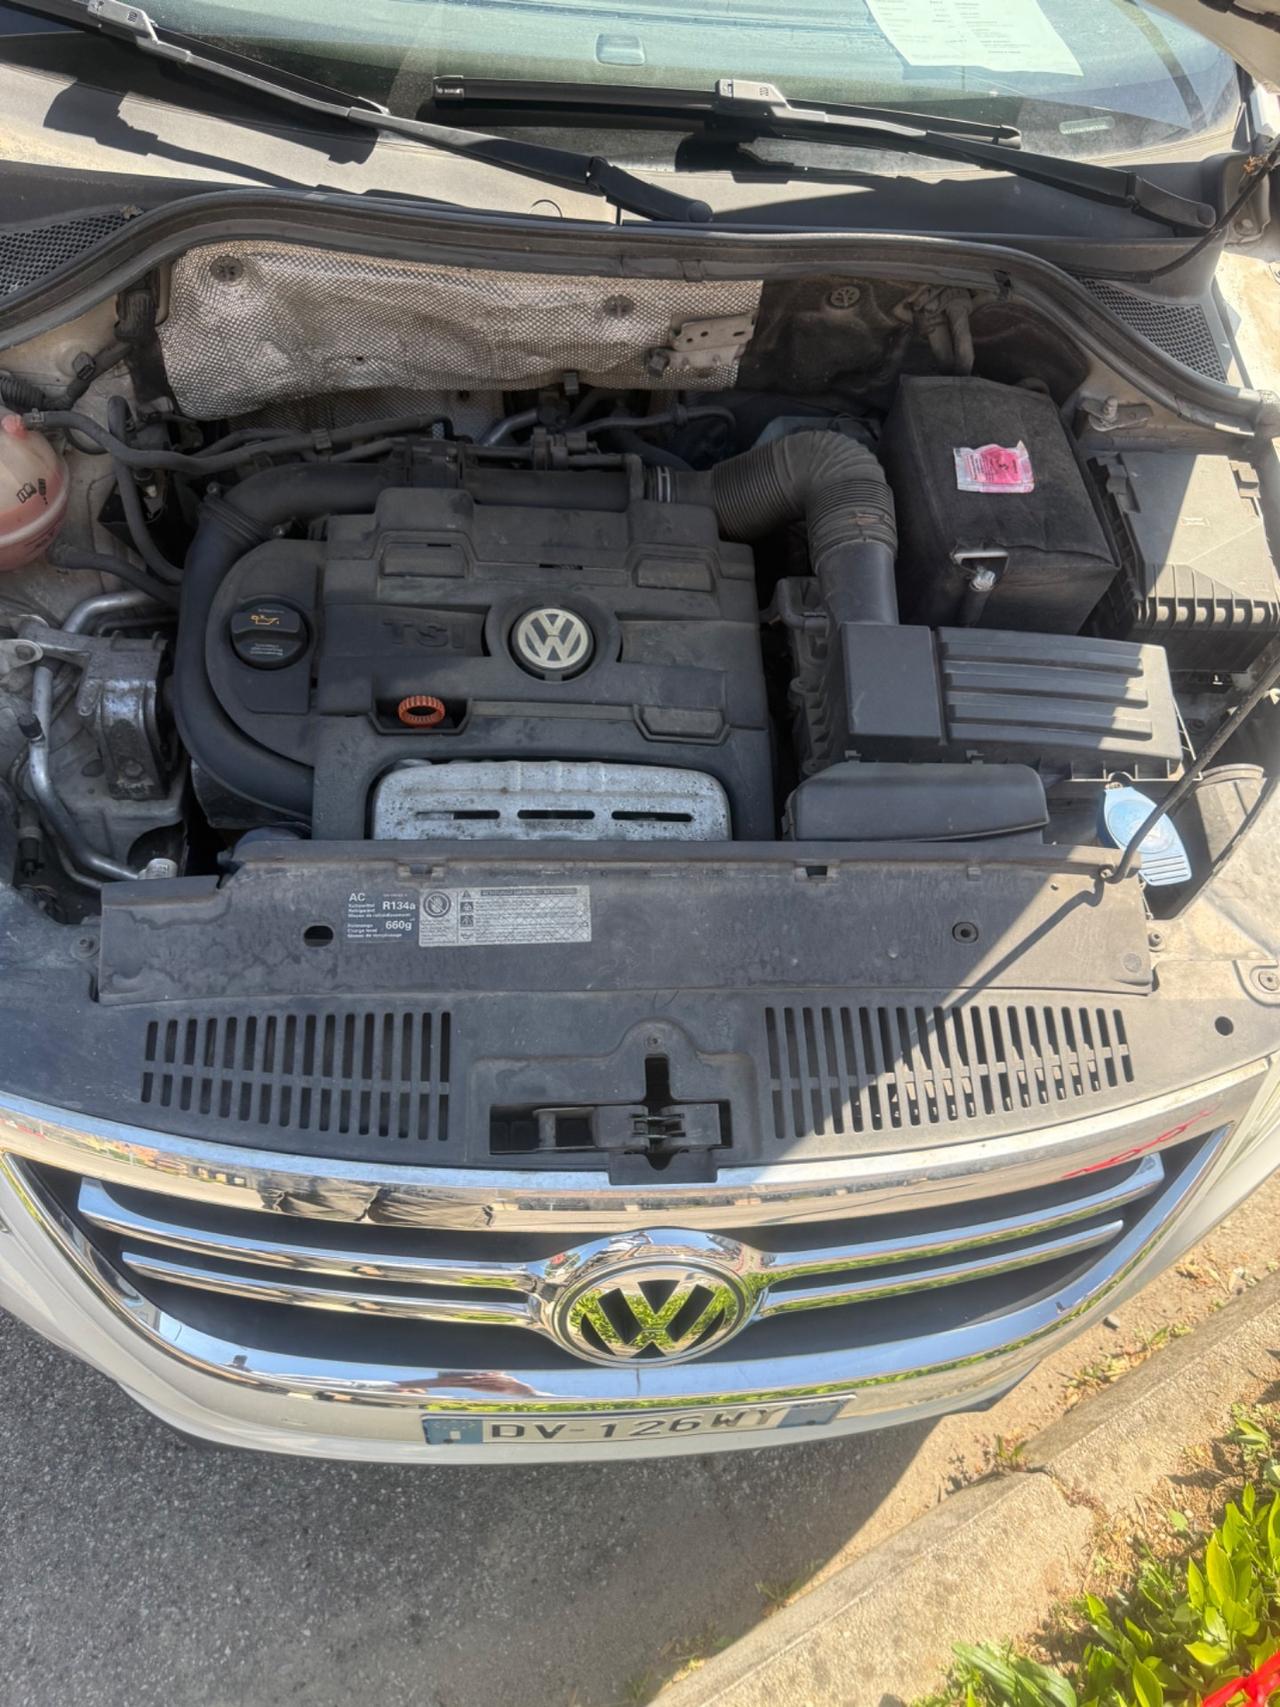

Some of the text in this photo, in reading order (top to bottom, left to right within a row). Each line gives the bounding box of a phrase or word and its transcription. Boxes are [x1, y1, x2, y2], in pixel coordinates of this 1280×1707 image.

[383, 621, 465, 649] TSI
[518, 608, 588, 668] VW
[348, 892, 366, 902] AC
[382, 900, 416, 911] R134a
[564, 1262, 740, 1363] VW
